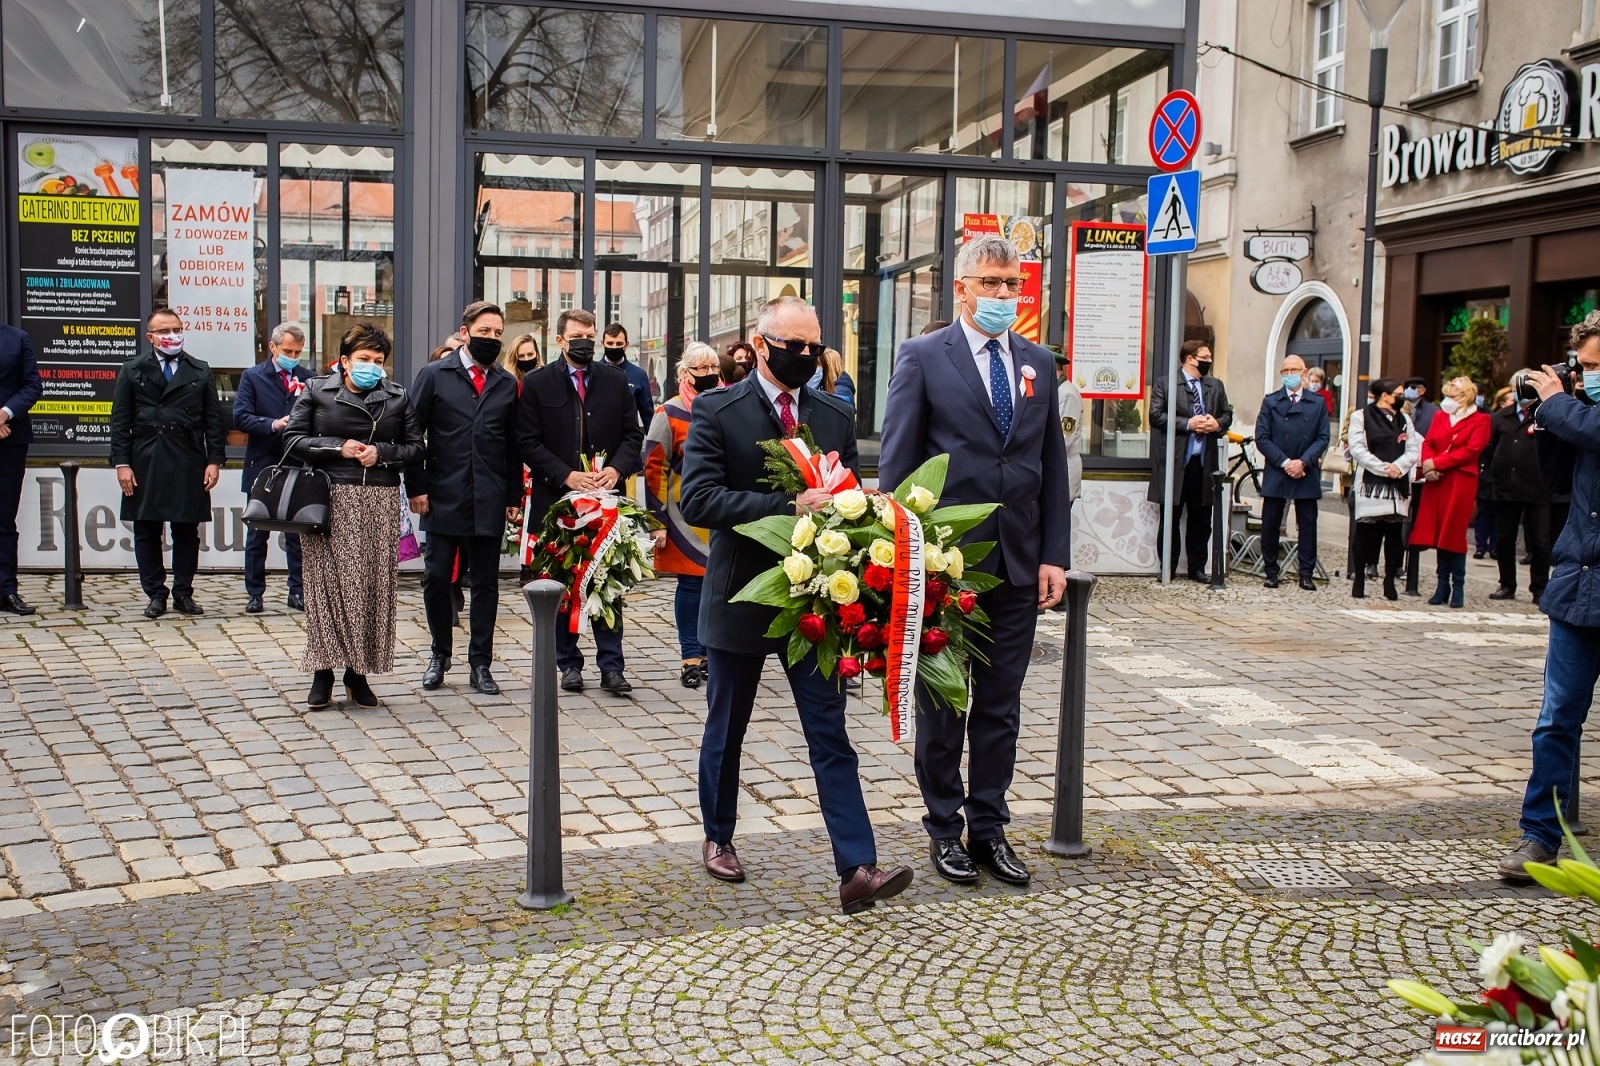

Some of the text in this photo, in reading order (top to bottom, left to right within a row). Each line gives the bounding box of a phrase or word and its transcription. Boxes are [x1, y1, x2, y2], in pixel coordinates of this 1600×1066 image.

[1382, 118, 1494, 188] Browar
[1499, 137, 1532, 160] Browar
[22, 198, 136, 222] CATERING DIETETYCZNY
[172, 201, 250, 223] ZAMÓW
[965, 216, 998, 226] Pizza Time
[72, 229, 136, 244] BEZ PSZENICY
[174, 229, 248, 241] Z DOWOZEM
[1086, 229, 1136, 244] LUNCH
[199, 245, 224, 255] LUB
[1262, 240, 1297, 255] BUTIK
[179, 260, 244, 272] ODBIOREM
[26, 277, 110, 289] ZDROWA I ZBILANSOWANA
[180, 275, 244, 287] W LOKALU
[176, 306, 248, 317] 32 415 84 84
[63, 325, 136, 336] W 5 KALORYCZNOŚCIACH
[194, 322, 213, 331] 415
[217, 322, 230, 332] 74
[234, 323, 248, 332] 75
[82, 339, 97, 347] 1800,
[38, 370, 116, 380] NAK Z DOBRYM GLUTENEM
[895, 566, 920, 598] RADY
[892, 602, 918, 646] POWIATU
[888, 651, 913, 736] RACIBORSKIEGO
